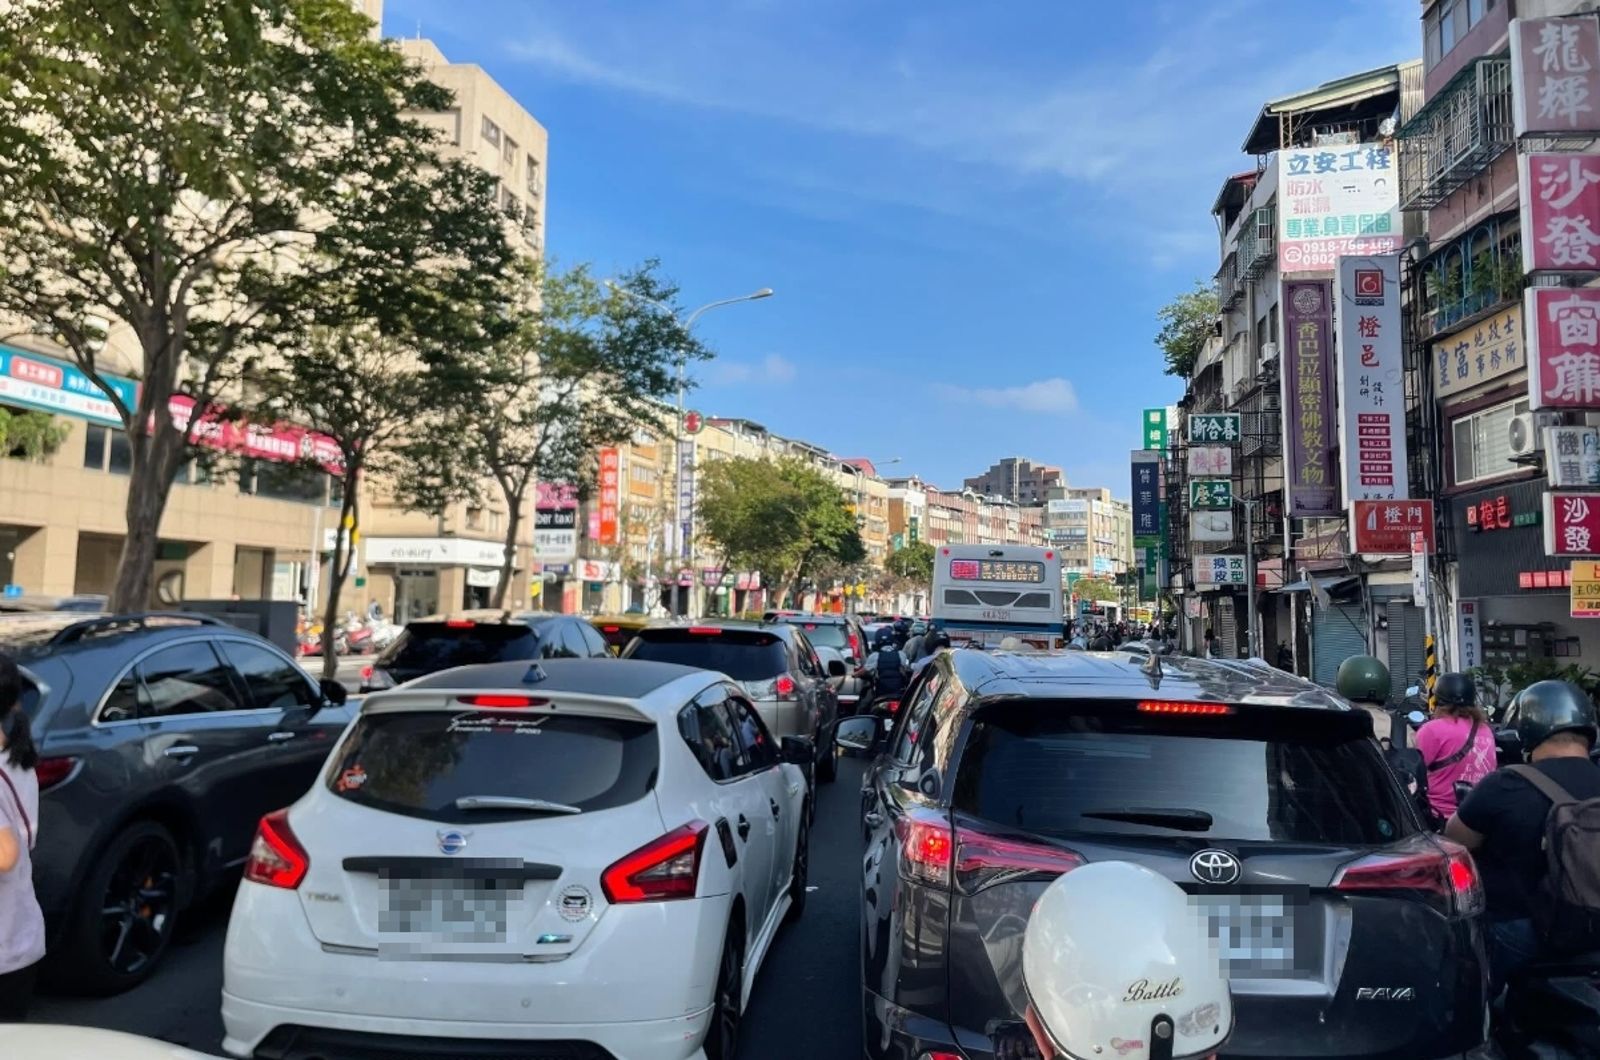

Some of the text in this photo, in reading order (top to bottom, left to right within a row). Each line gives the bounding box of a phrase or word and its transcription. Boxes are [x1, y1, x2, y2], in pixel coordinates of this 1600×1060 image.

[1532, 22, 1592, 127] 龍輝
[1287, 147, 1391, 176] 立安工程
[1287, 180, 1323, 196] 防水
[1539, 158, 1600, 266] 沙發
[1358, 315, 1381, 367] 橙邑
[1192, 417, 1238, 440] 新合春
[1384, 506, 1424, 524] 橙門
[1563, 498, 1591, 552] 沙發
[1122, 977, 1181, 1002] Battle
[1355, 987, 1416, 1001] RAV4
